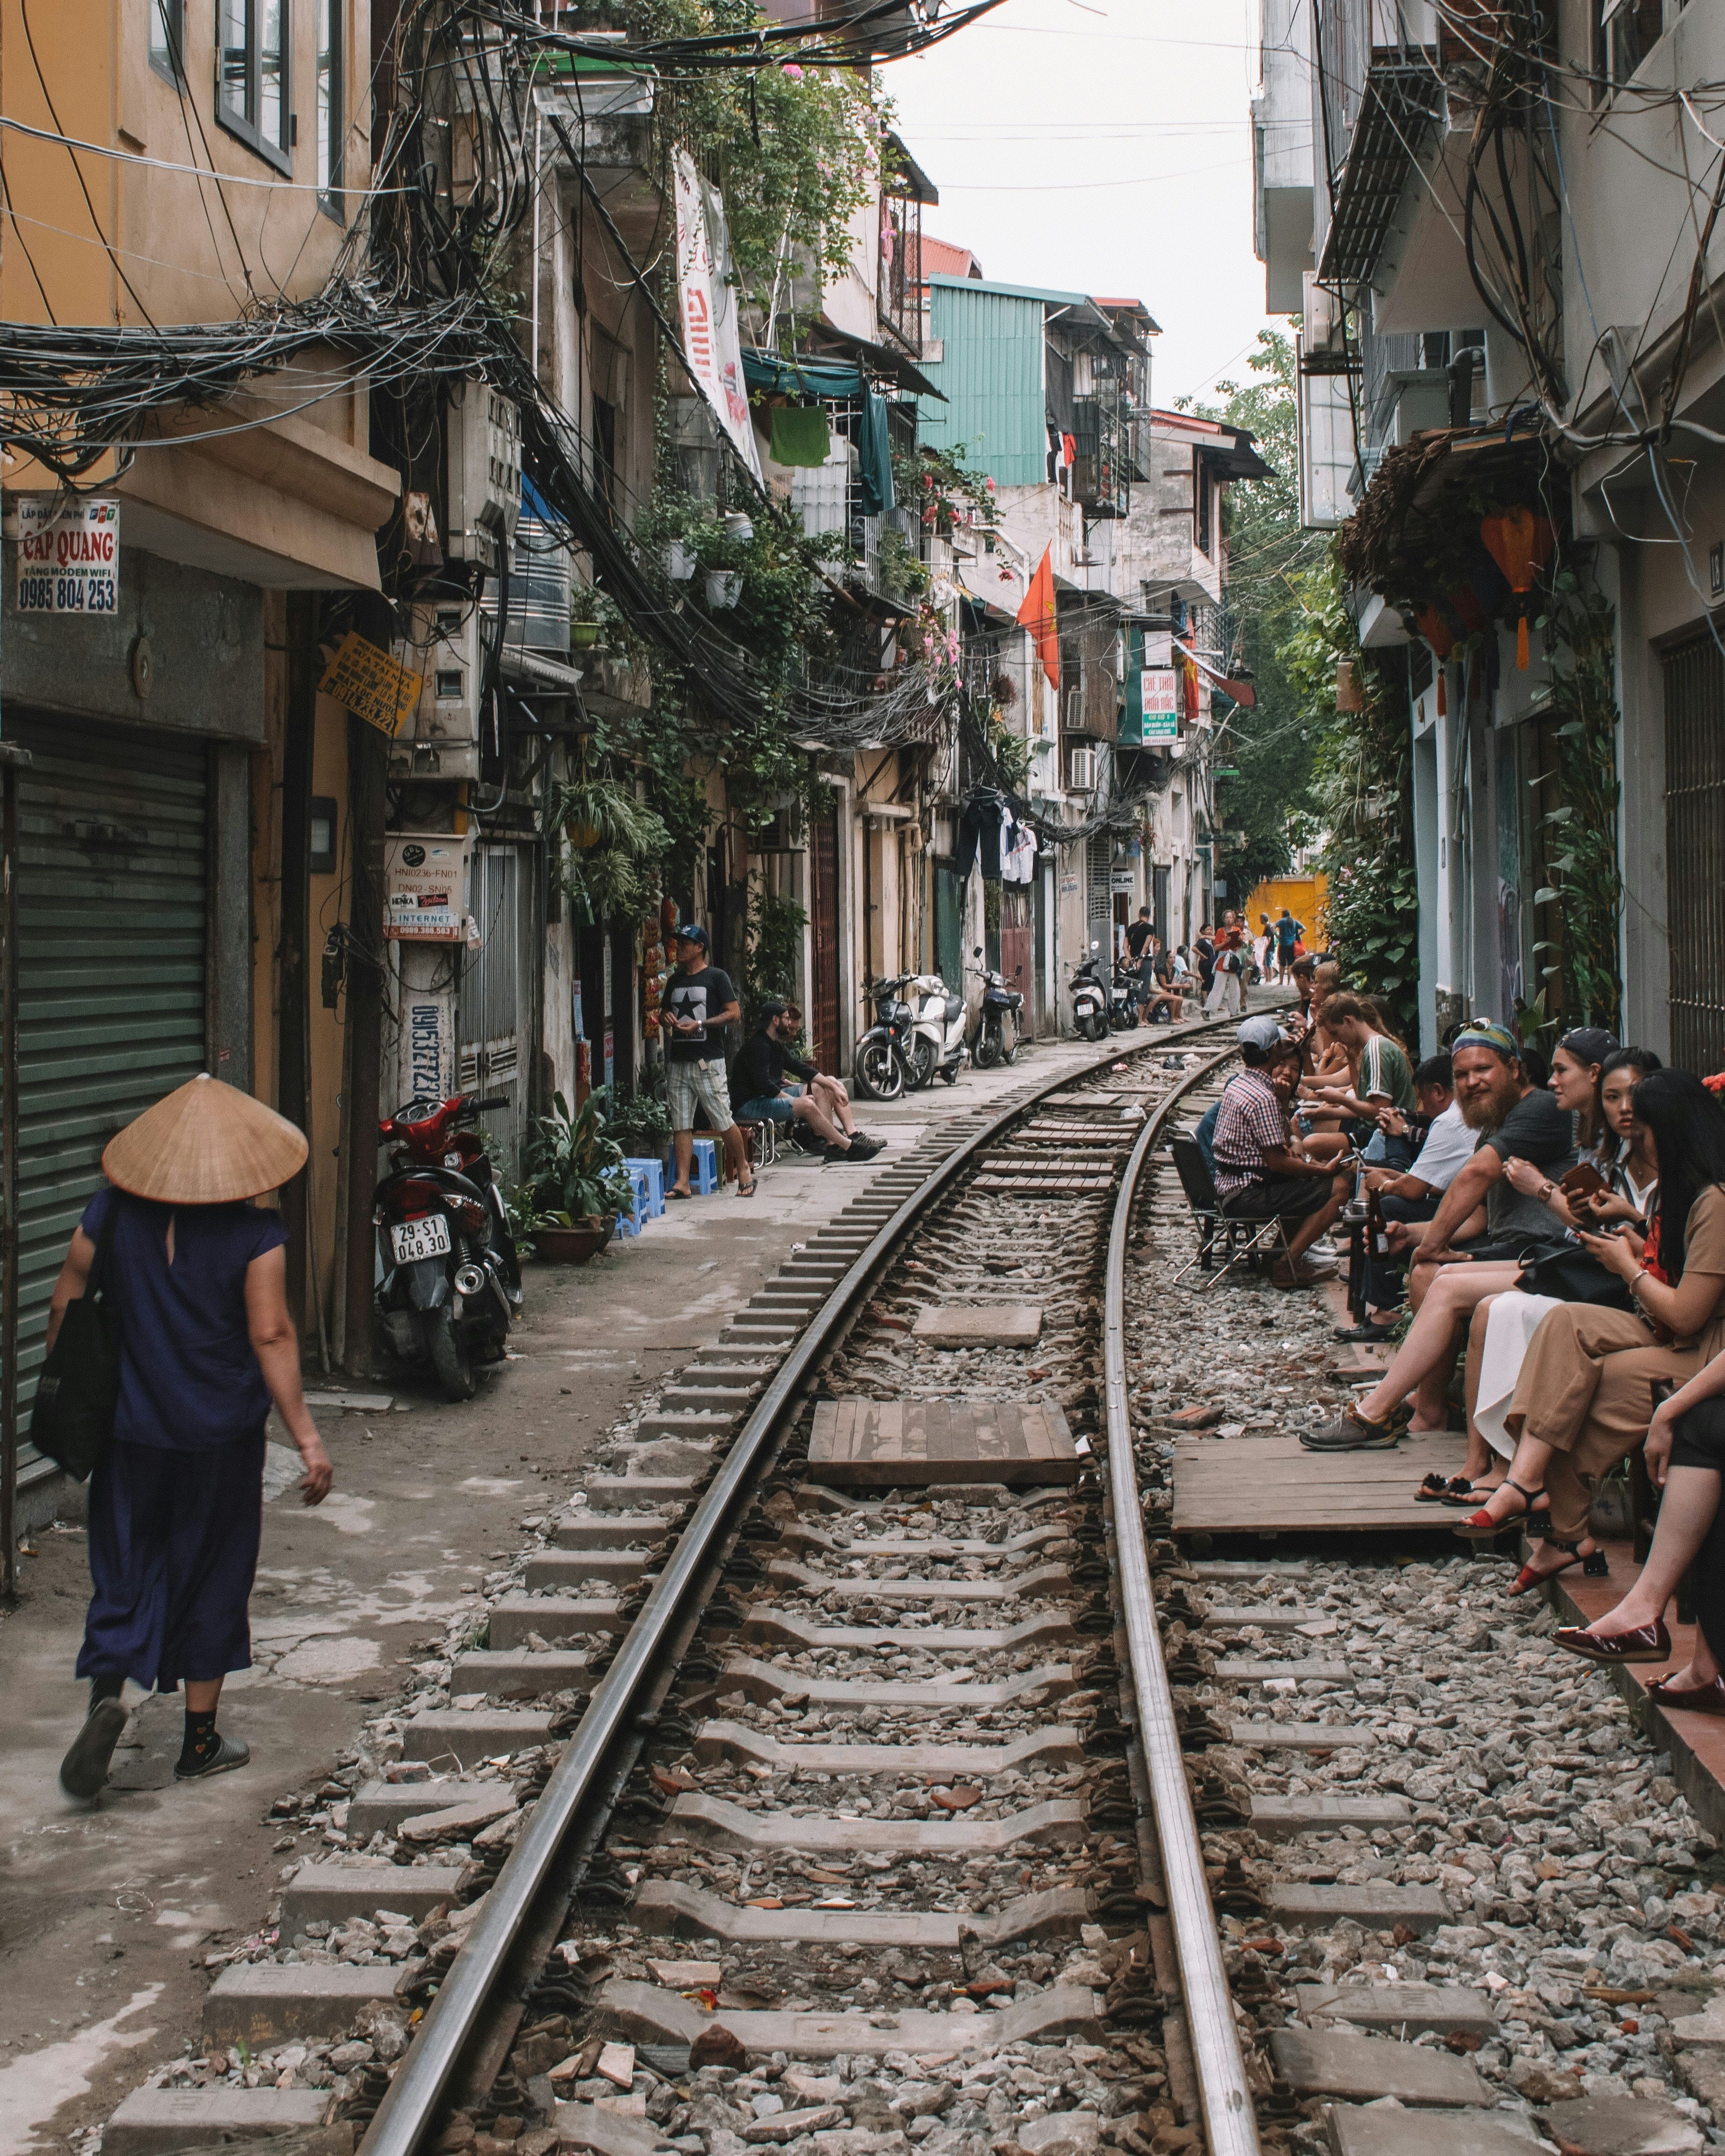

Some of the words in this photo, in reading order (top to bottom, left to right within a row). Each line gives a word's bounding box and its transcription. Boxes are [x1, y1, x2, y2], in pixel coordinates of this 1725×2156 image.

[90, 507, 115, 523] FPT
[57, 531, 113, 567] QUANG
[51, 568, 88, 577] MODEM
[90, 568, 110, 577] WIFI
[20, 578, 53, 608] 0985
[57, 578, 84, 610] 804
[88, 580, 114, 610] 253
[392, 894, 414, 905] HENKA
[400, 1220, 438, 1242] 29-S1
[399, 1235, 445, 1260] 048.30
